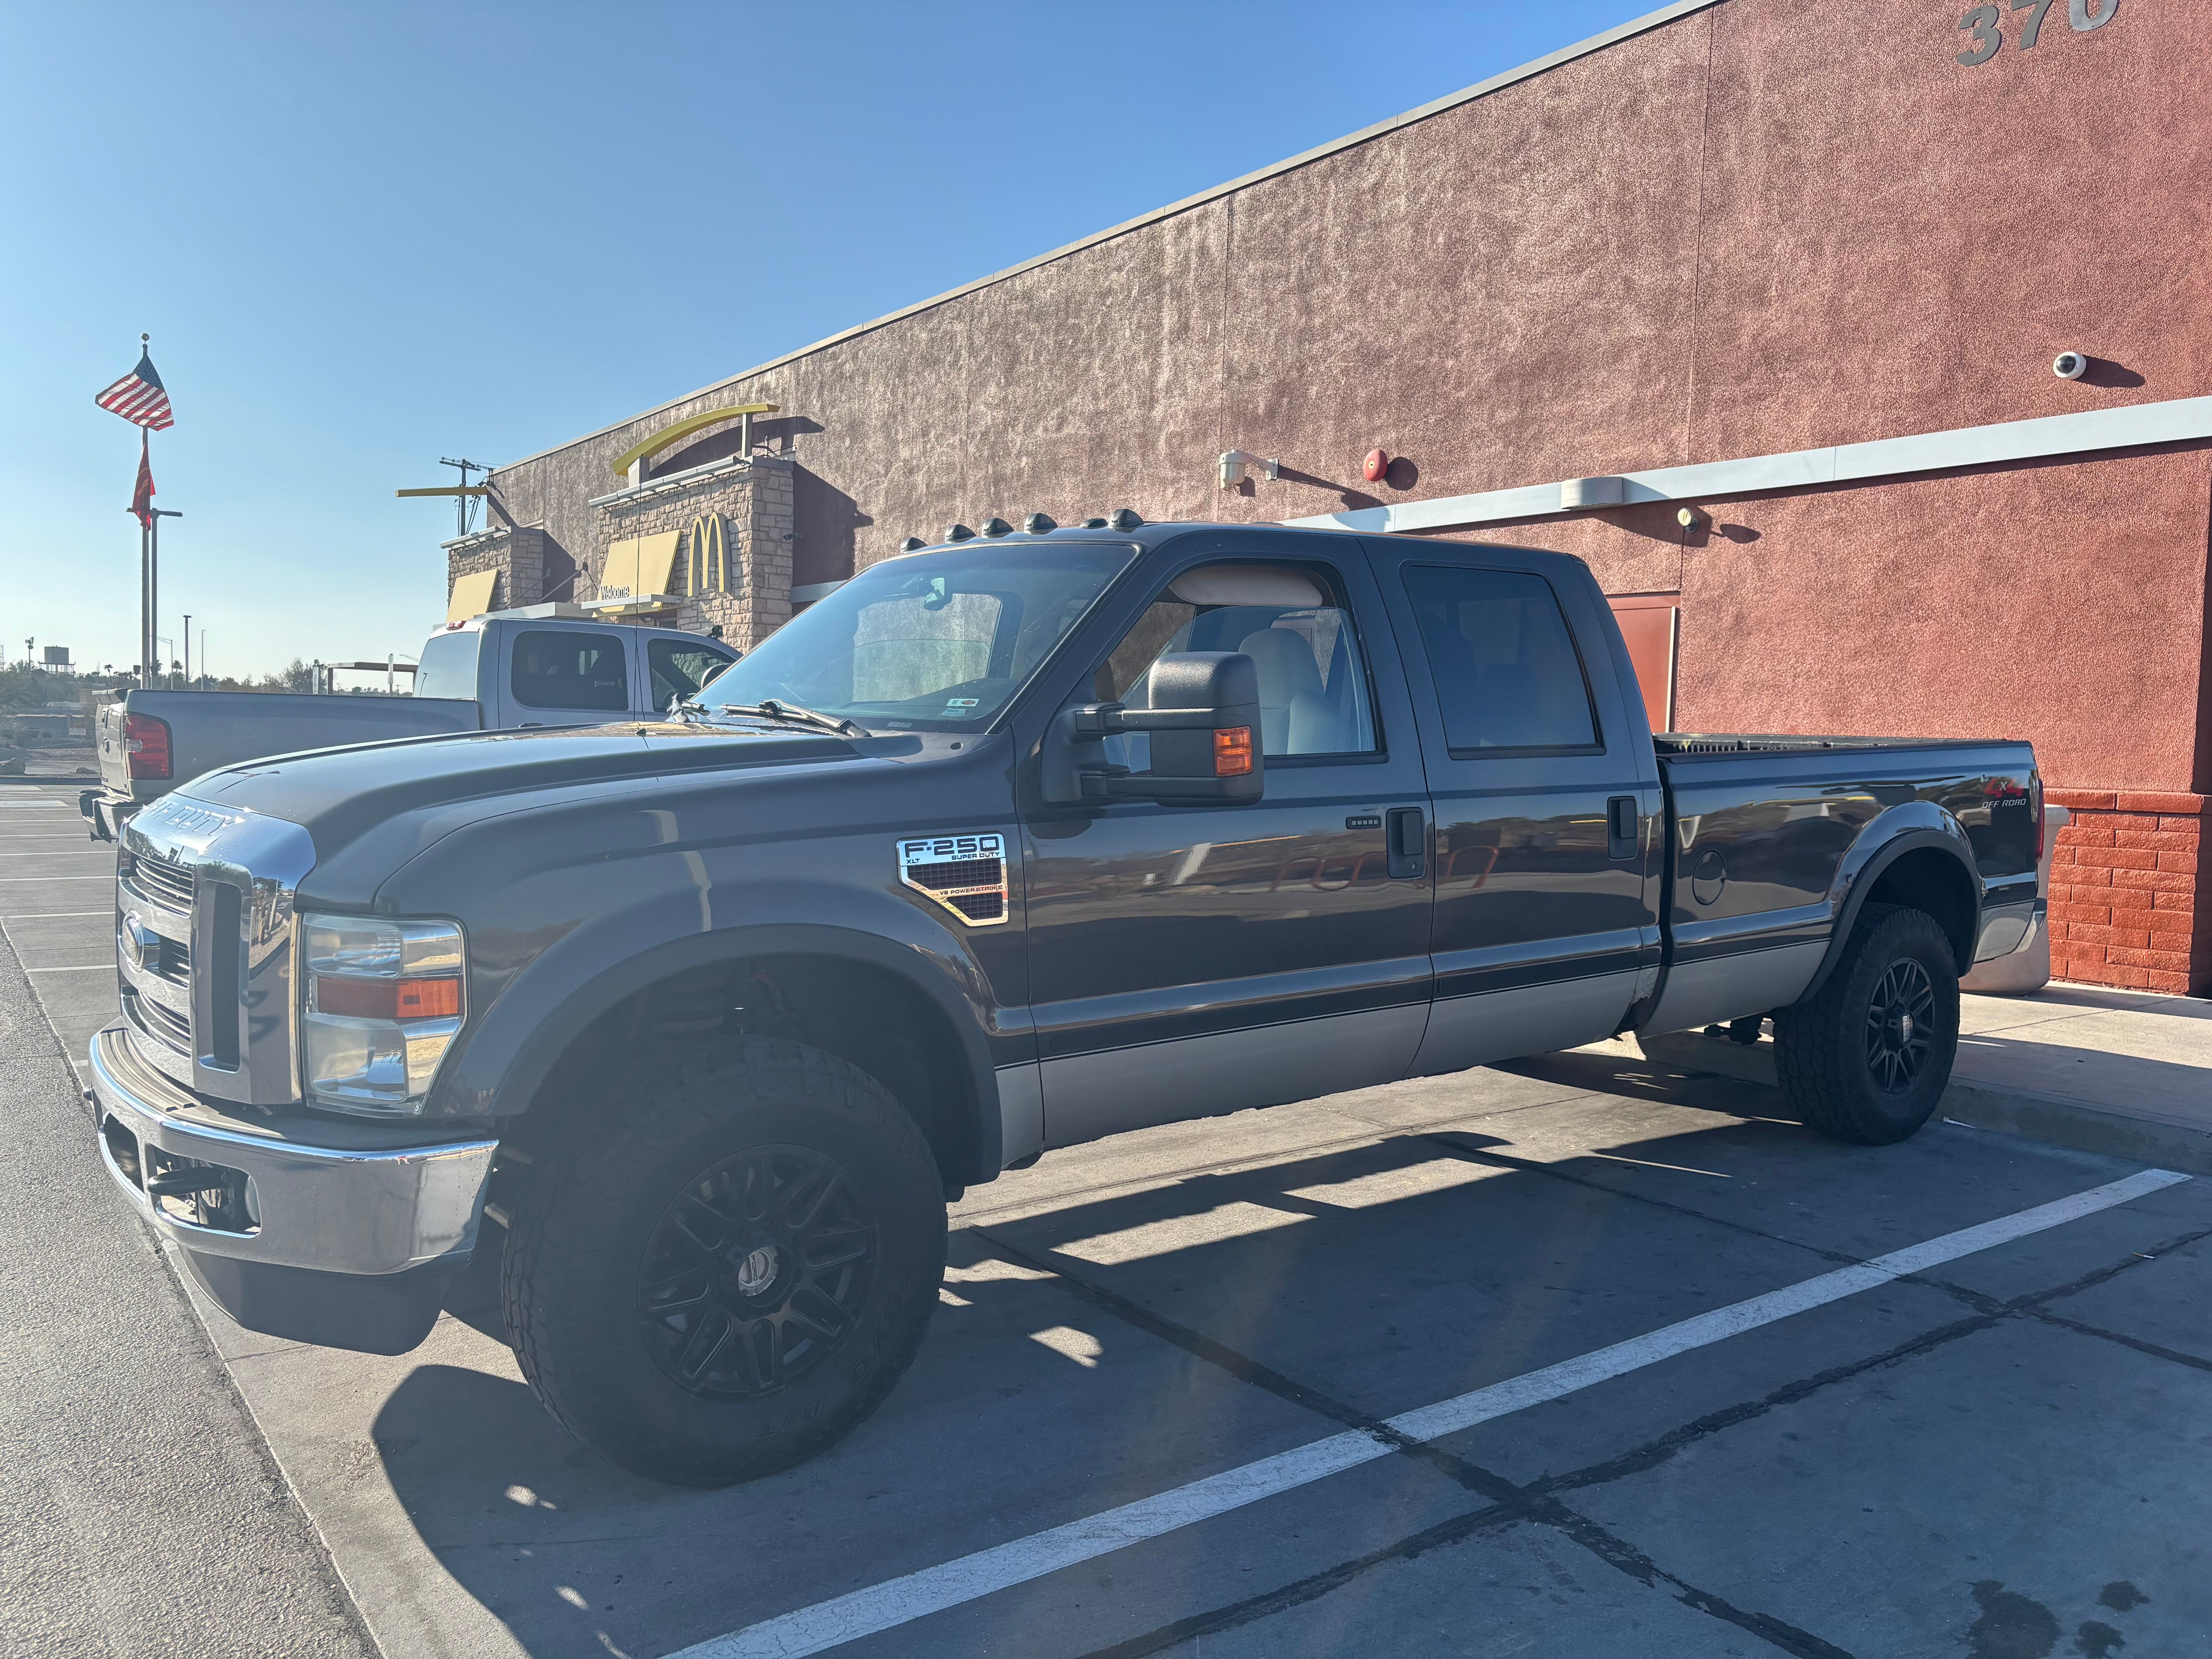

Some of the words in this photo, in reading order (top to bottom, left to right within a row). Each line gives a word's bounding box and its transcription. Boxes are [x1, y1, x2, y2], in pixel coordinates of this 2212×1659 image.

[1957, 0, 2118, 66] 370
[601, 585, 629, 600] Welcome
[905, 836, 999, 858] F-250
